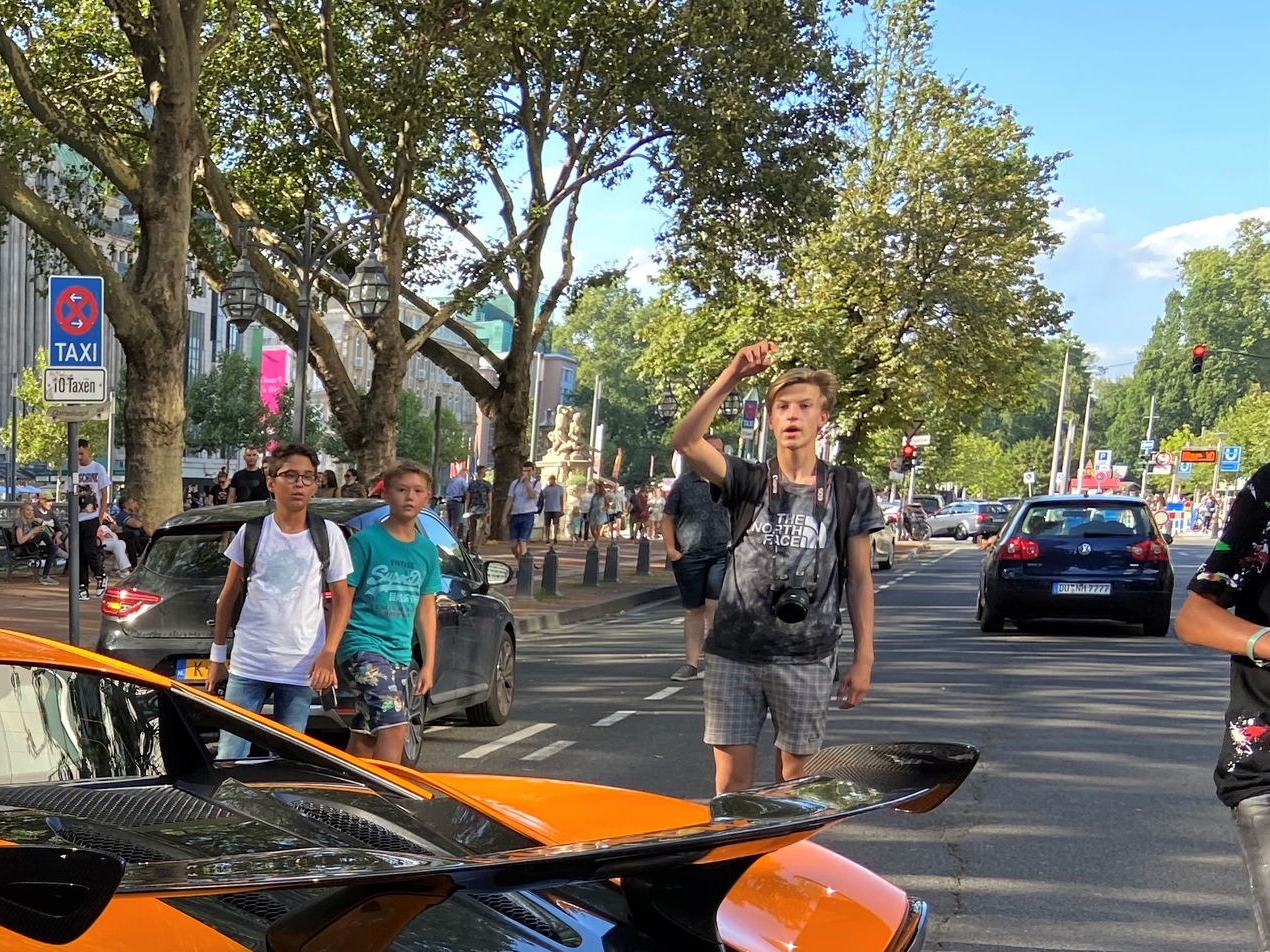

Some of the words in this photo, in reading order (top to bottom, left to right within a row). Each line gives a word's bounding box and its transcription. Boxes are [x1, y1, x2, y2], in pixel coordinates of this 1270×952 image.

[54, 343, 97, 362] TAXI
[68, 377, 96, 393] Taxen
[777, 513, 806, 525] THE
[751, 521, 803, 536] NORTH
[763, 534, 802, 548] FACE
